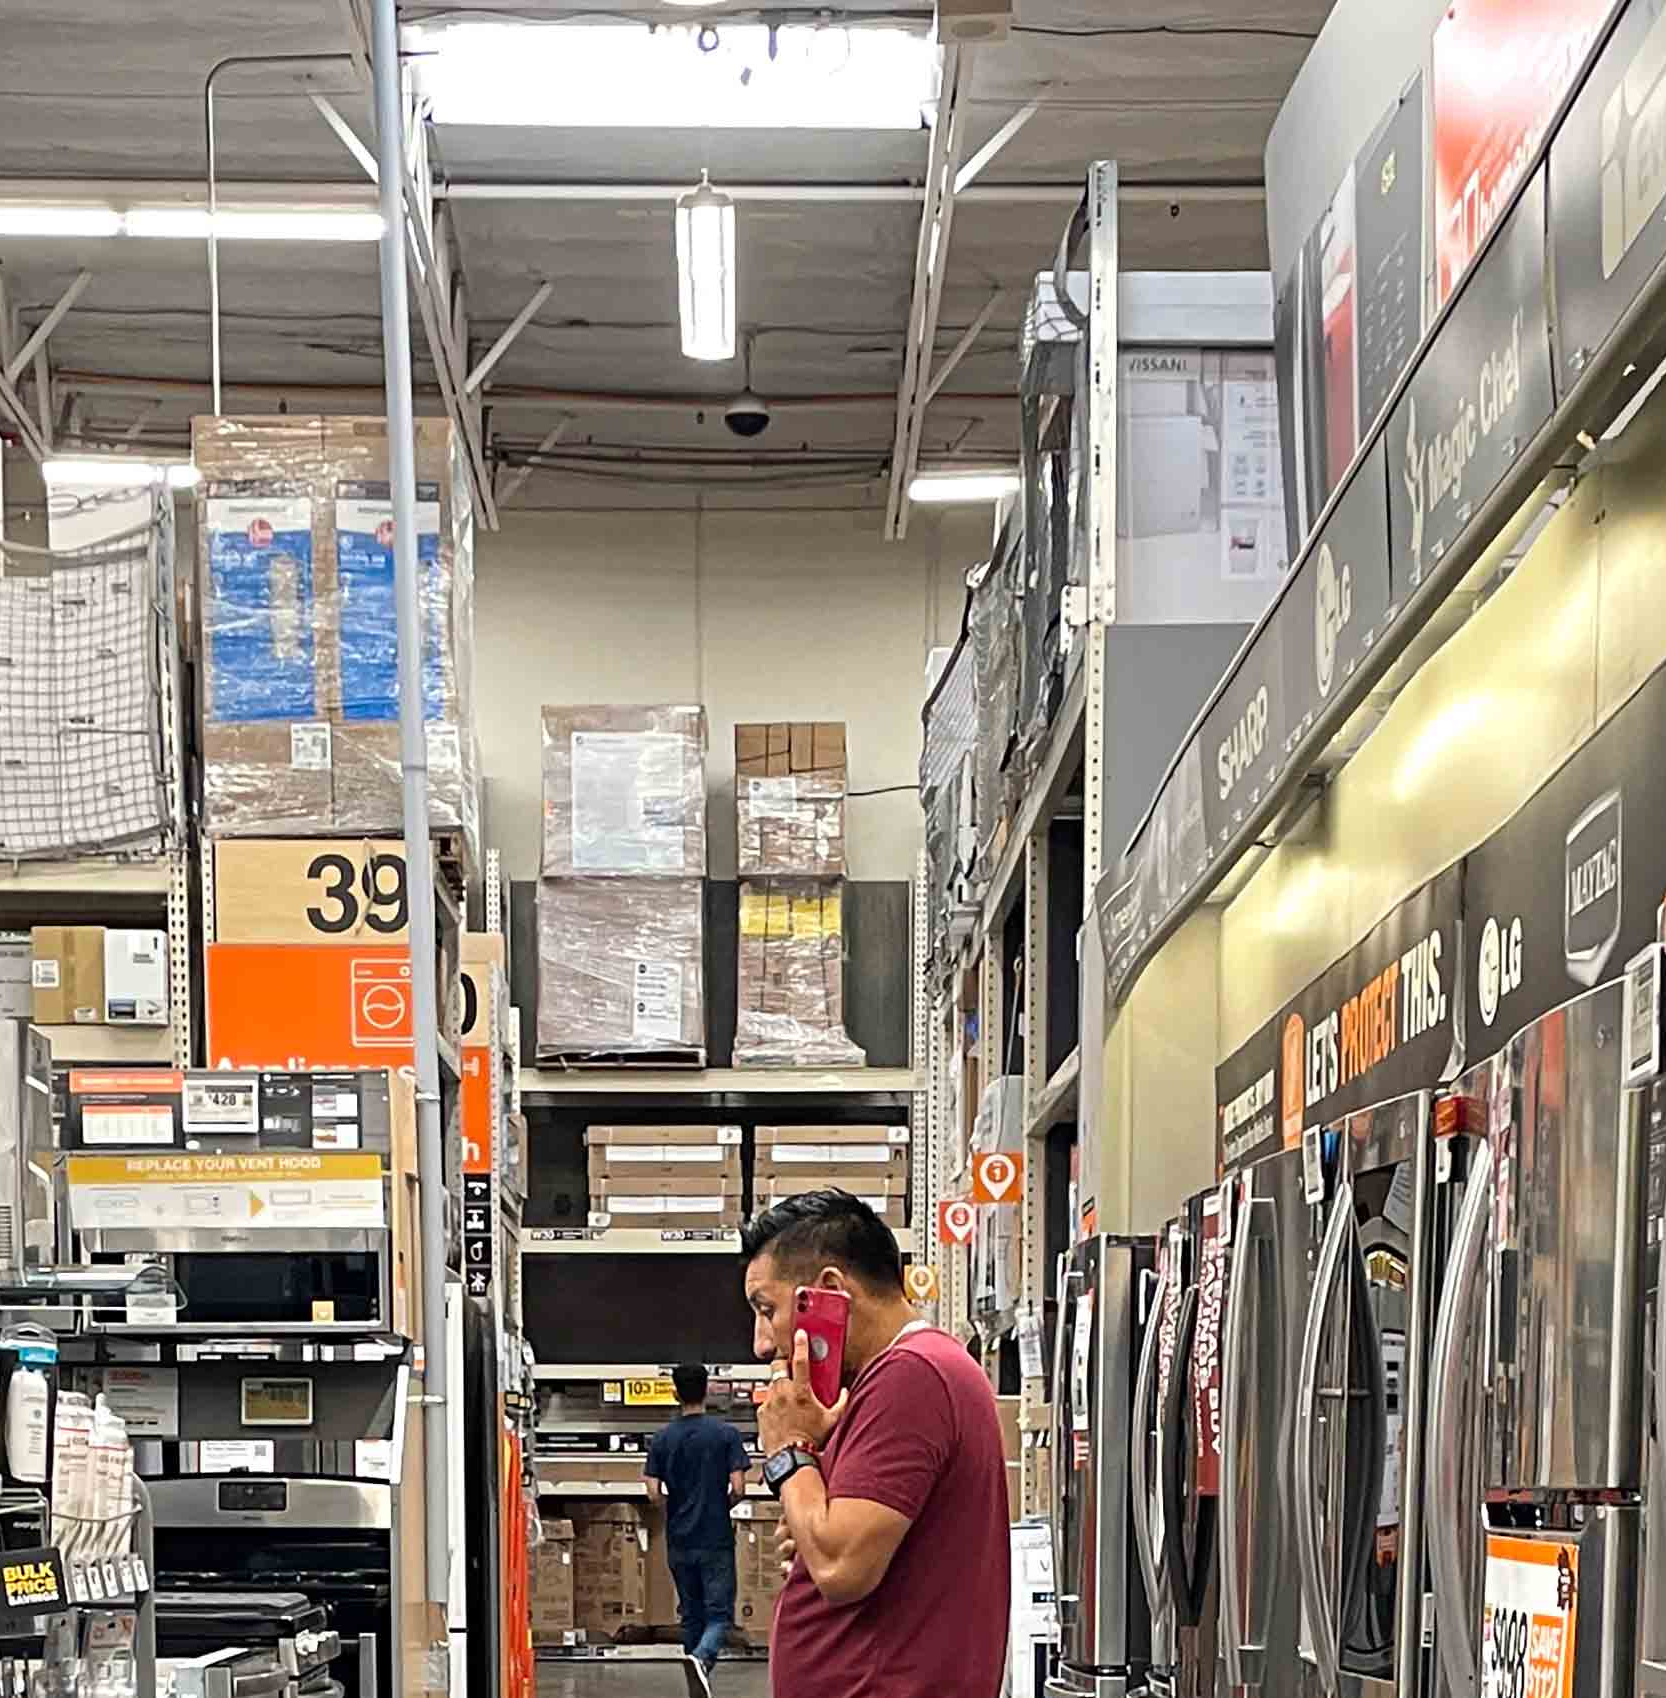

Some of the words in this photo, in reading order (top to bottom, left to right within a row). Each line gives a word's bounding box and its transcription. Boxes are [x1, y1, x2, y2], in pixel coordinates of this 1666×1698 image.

[1426, 383, 1476, 513] Magic
[1479, 315, 1523, 438] Chef
[1334, 565, 1351, 638] LG
[1217, 684, 1270, 782] SHARP
[305, 854, 410, 934] 39
[1570, 839, 1617, 917] MAYTAG
[1500, 917, 1523, 996] LG
[1305, 1009, 1339, 1108] LET'S
[1341, 960, 1399, 1086] PROTECT
[1401, 930, 1446, 1042] THIS.
[125, 1158, 193, 1172] REPLACE
[194, 1157, 237, 1170] YOUR
[238, 1157, 276, 1170] VENT
[278, 1156, 321, 1170] HOOD
[2, 1562, 54, 1582] BULK
[5, 1578, 57, 1597] PRICE
[1532, 1624, 1563, 1662] SAVE
